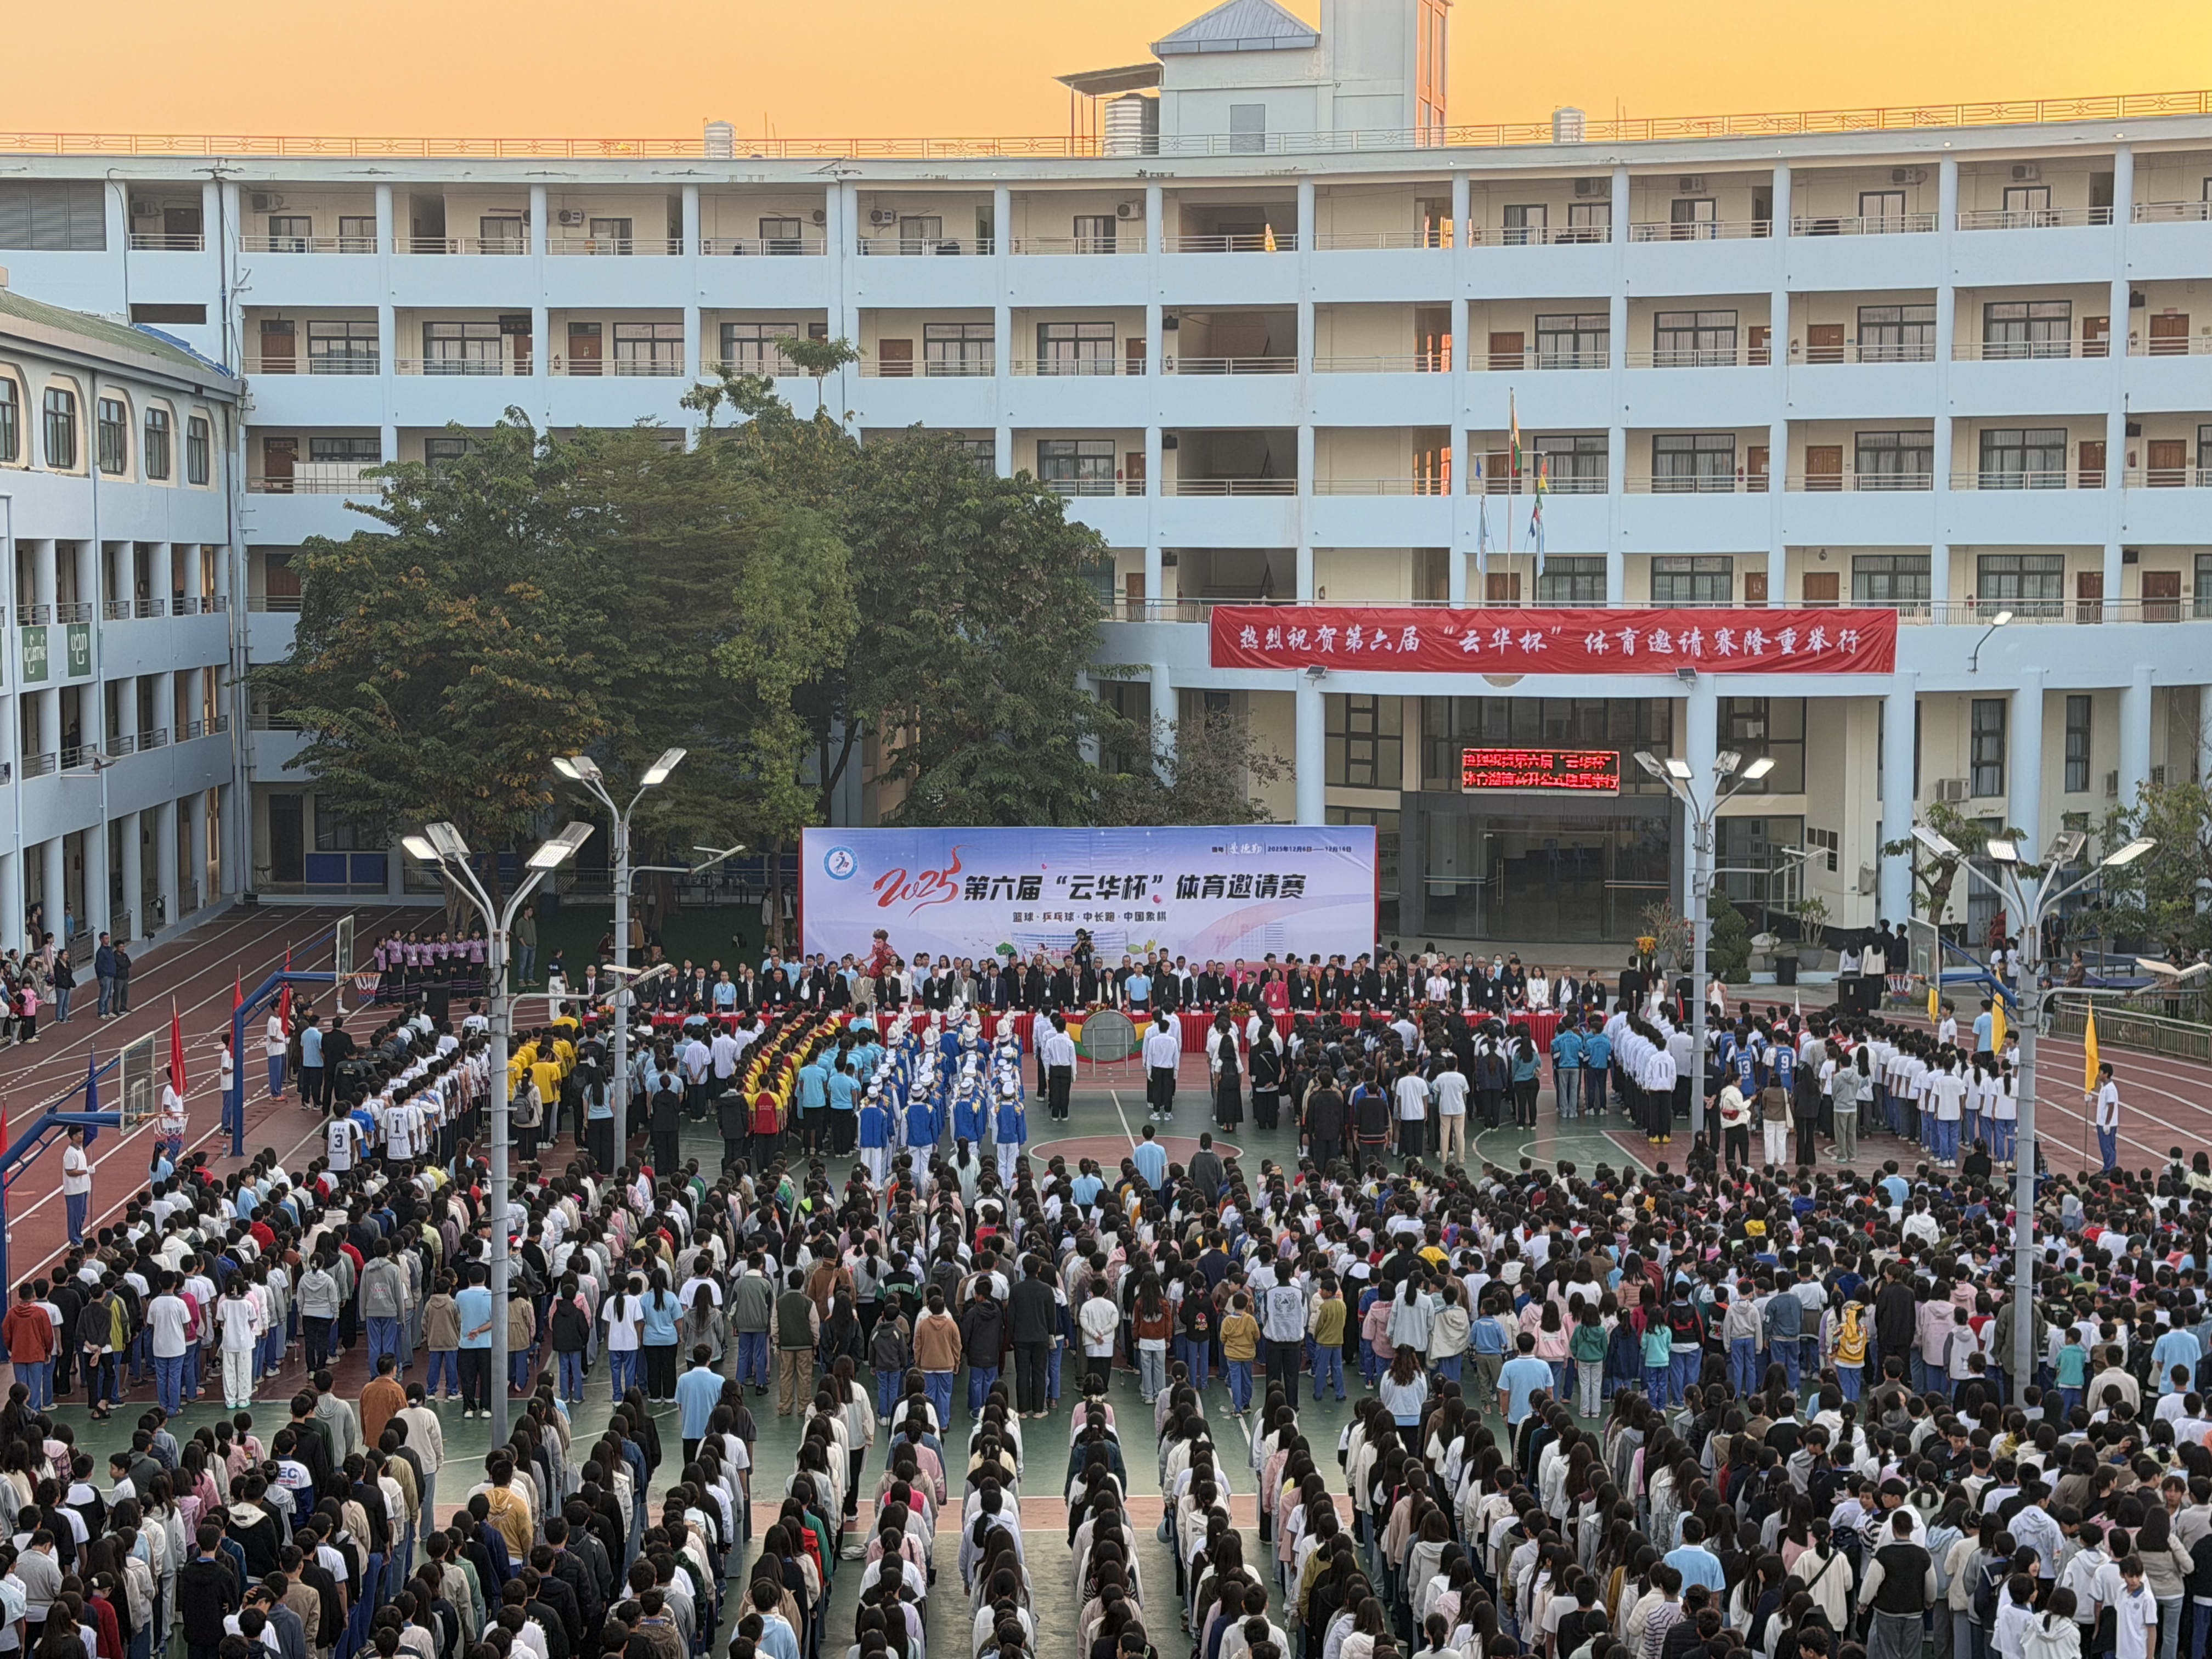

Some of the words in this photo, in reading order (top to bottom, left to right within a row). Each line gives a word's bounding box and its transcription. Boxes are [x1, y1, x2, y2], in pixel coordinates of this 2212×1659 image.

[1239, 623, 1861, 658] 热烈祝贺第六届“云华杯”体育邀请赛隆重举行
[870, 846, 968, 917] 2025
[964, 873, 1306, 901] 第六届“云华杯”体育邀请赛
[1737, 1060, 1751, 1075] 13
[1781, 1055, 1789, 1069] 9
[1658, 1062, 1668, 1079] 11
[394, 1119, 400, 1134] 1
[334, 1134, 343, 1148] 3
